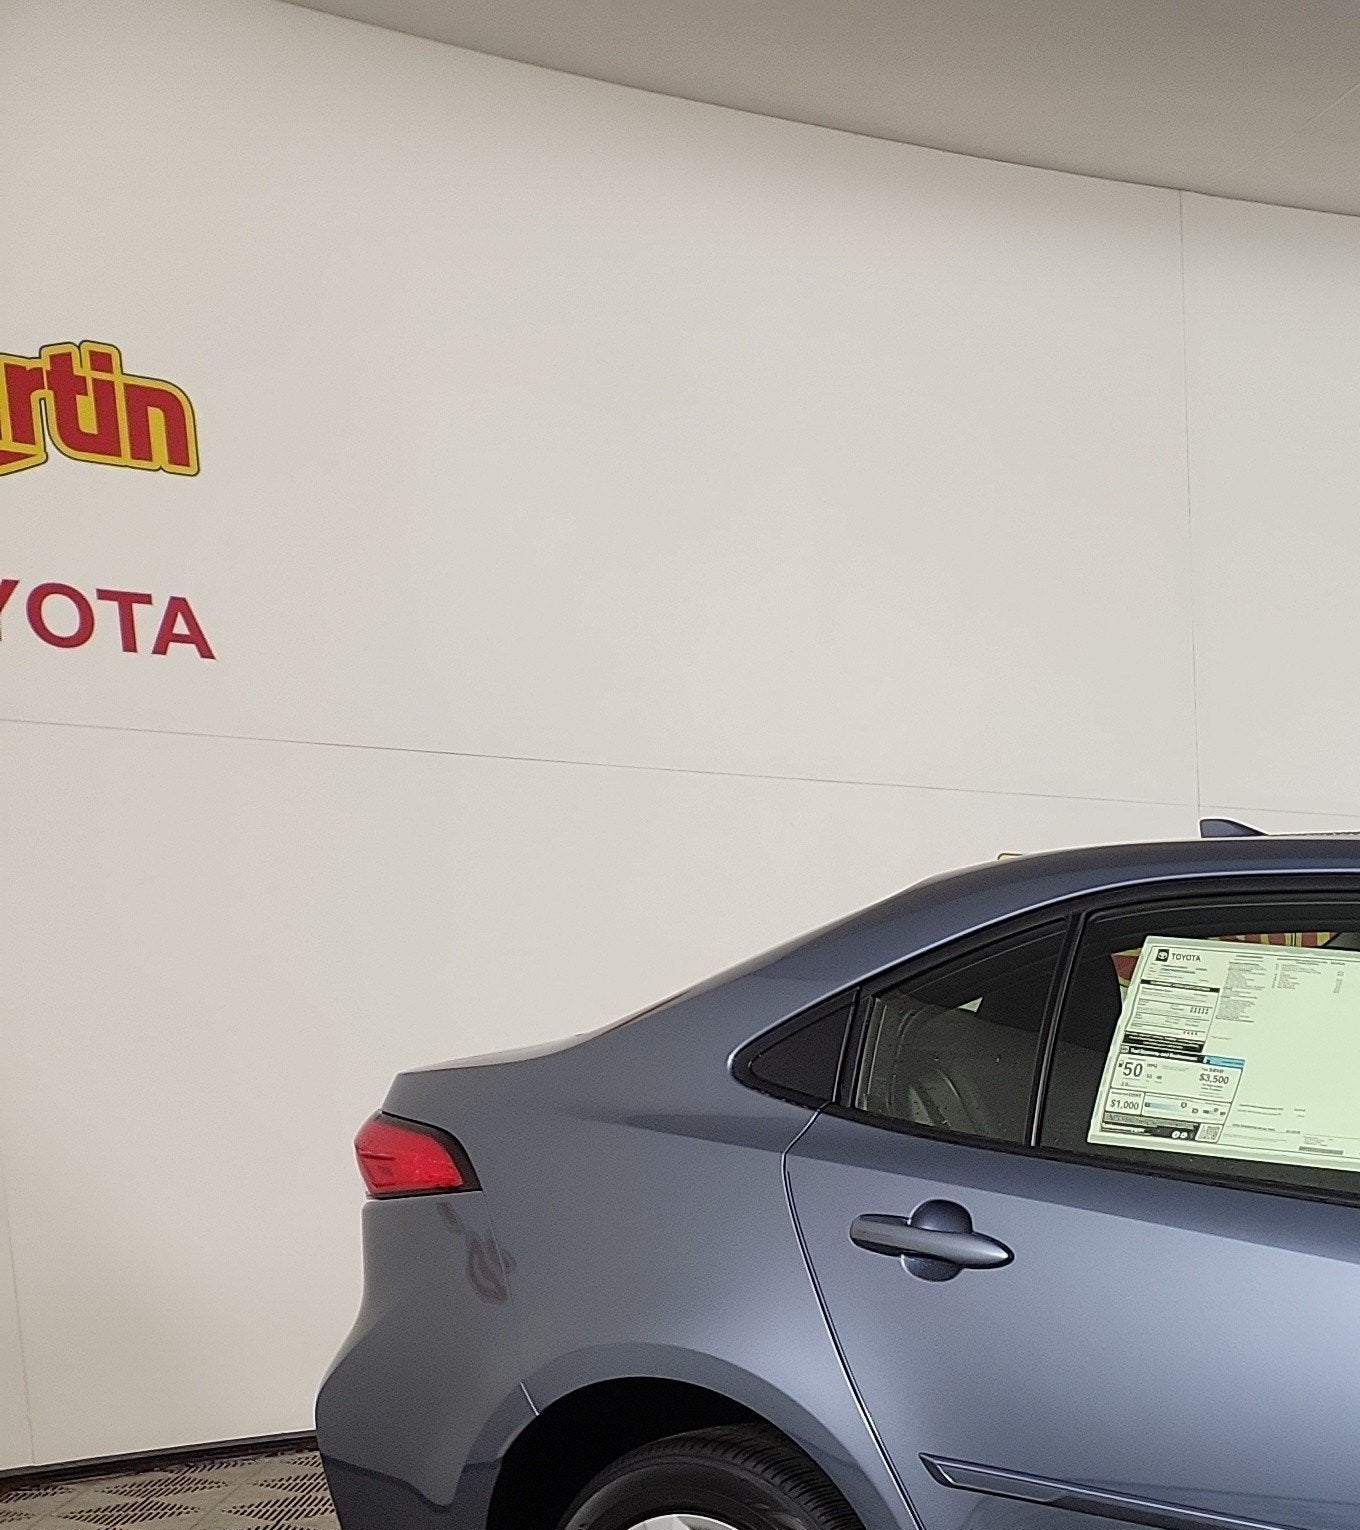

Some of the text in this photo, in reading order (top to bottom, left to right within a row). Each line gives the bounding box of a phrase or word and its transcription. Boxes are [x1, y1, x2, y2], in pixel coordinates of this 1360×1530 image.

[0, 350, 192, 469] rtin
[1171, 953, 1201, 962] TOYOTA
[1122, 1061, 1143, 1078] 50
[1198, 1073, 1230, 1085] $3,500
[1110, 1099, 1140, 1110] $1,000
